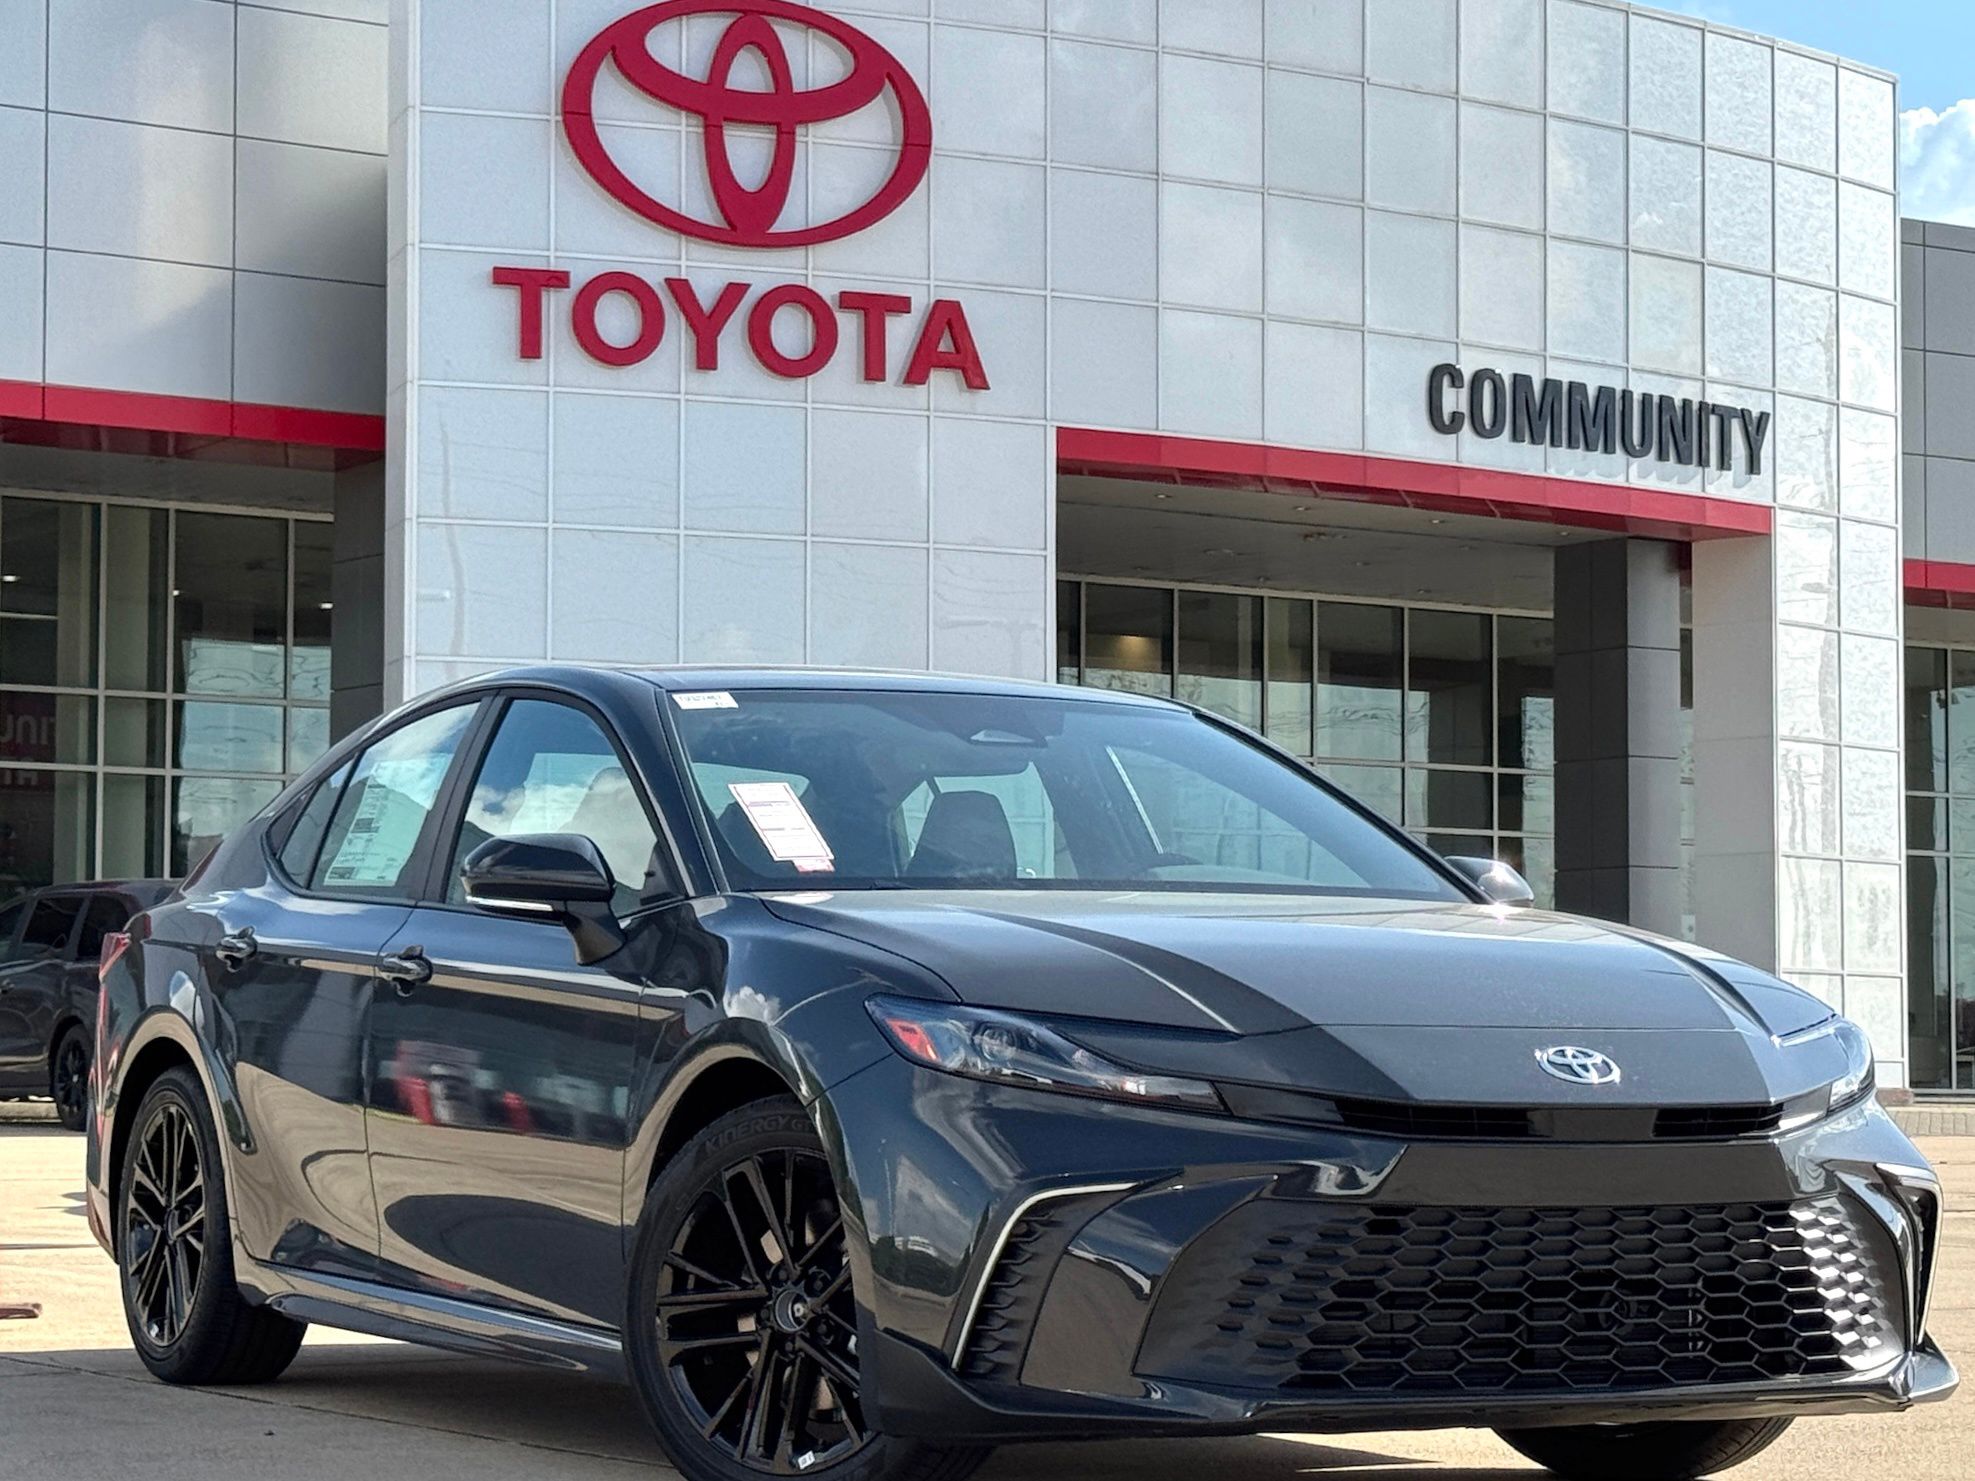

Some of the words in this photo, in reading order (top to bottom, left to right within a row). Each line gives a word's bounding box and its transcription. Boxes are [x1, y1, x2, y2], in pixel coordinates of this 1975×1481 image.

[492, 266, 991, 391] TOYOTA
[1428, 363, 1771, 476] COMMUNITY
[705, 1115, 790, 1155] KINERGY
